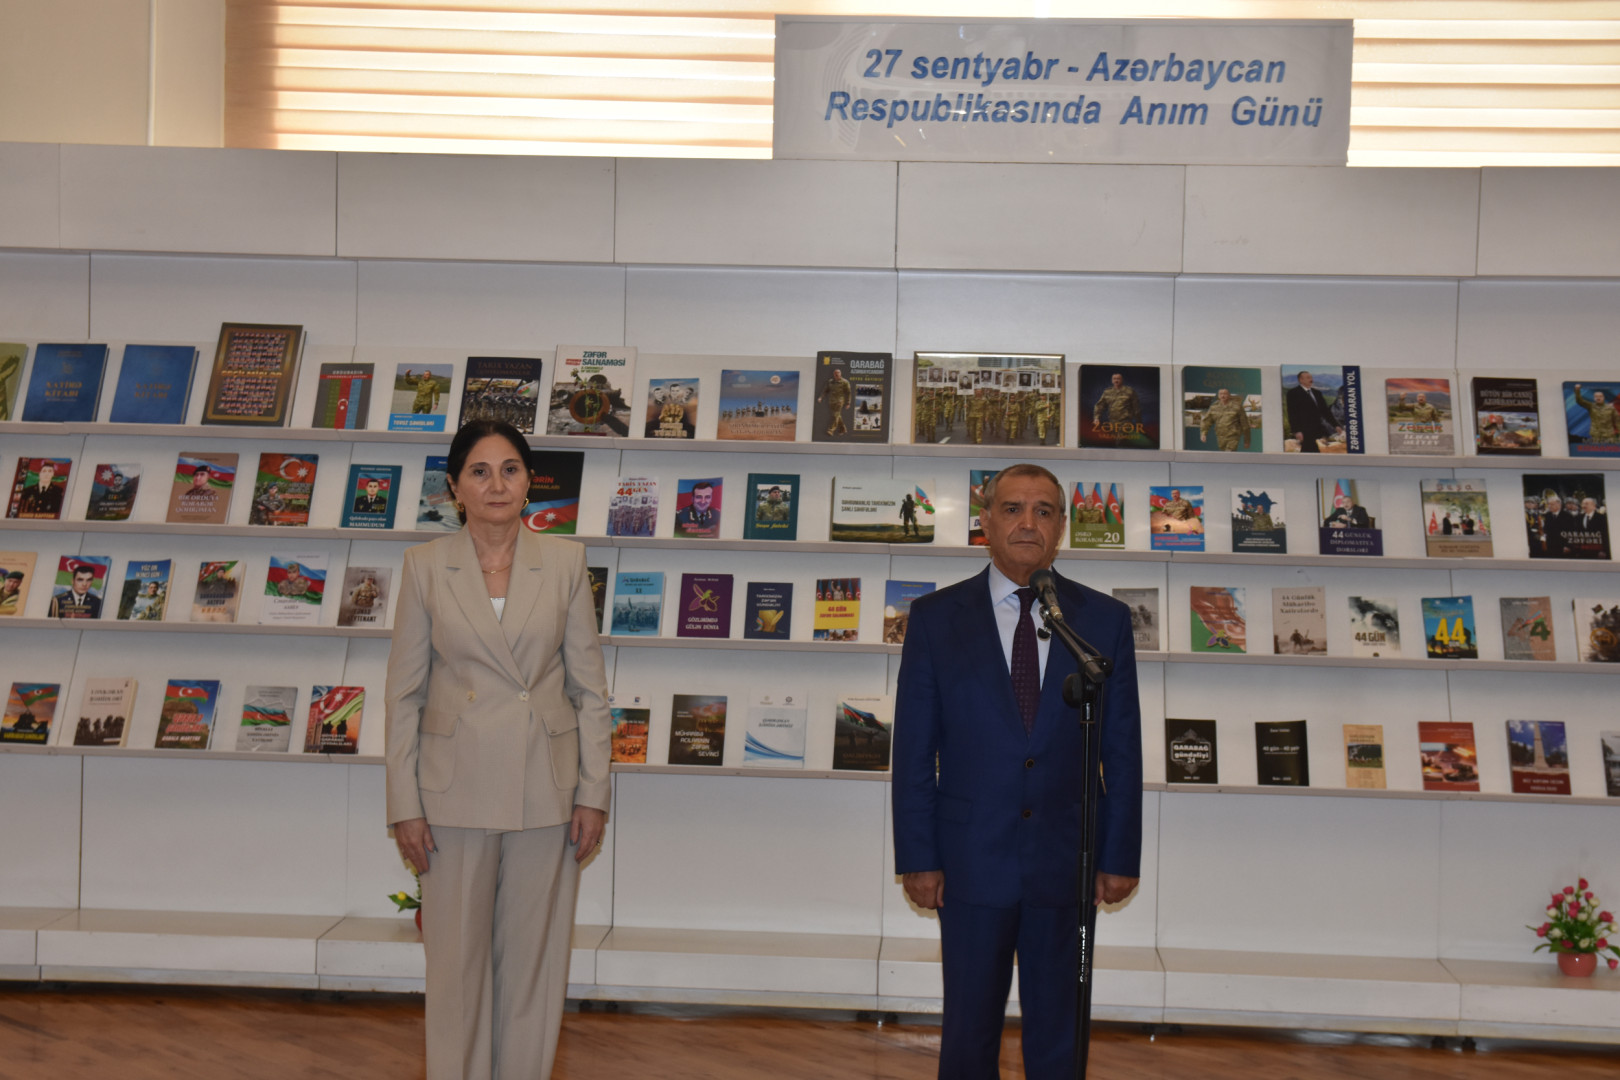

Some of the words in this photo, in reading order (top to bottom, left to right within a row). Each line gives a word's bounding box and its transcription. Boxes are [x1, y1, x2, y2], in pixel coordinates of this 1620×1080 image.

[864, 48, 902, 79] 27
[911, 51, 1059, 88] sentyabr
[1086, 52, 1286, 90] Azərbaycan
[825, 91, 1102, 129] Respublikasında
[1120, 96, 1208, 126] Anım
[1231, 96, 1324, 128] Günü
[850, 359, 885, 369] QARABAĞ
[1346, 371, 1356, 386] YOL
[1347, 387, 1358, 418] APARAN
[1350, 419, 1360, 451] ZƏFƏRƏ
[617, 487, 633, 496] 44
[1103, 531, 1120, 544] 20
[1331, 530, 1344, 539] 44
[1354, 632, 1368, 642] 44
[1369, 631, 1387, 643] GÜN
[1434, 617, 1468, 646] 44
